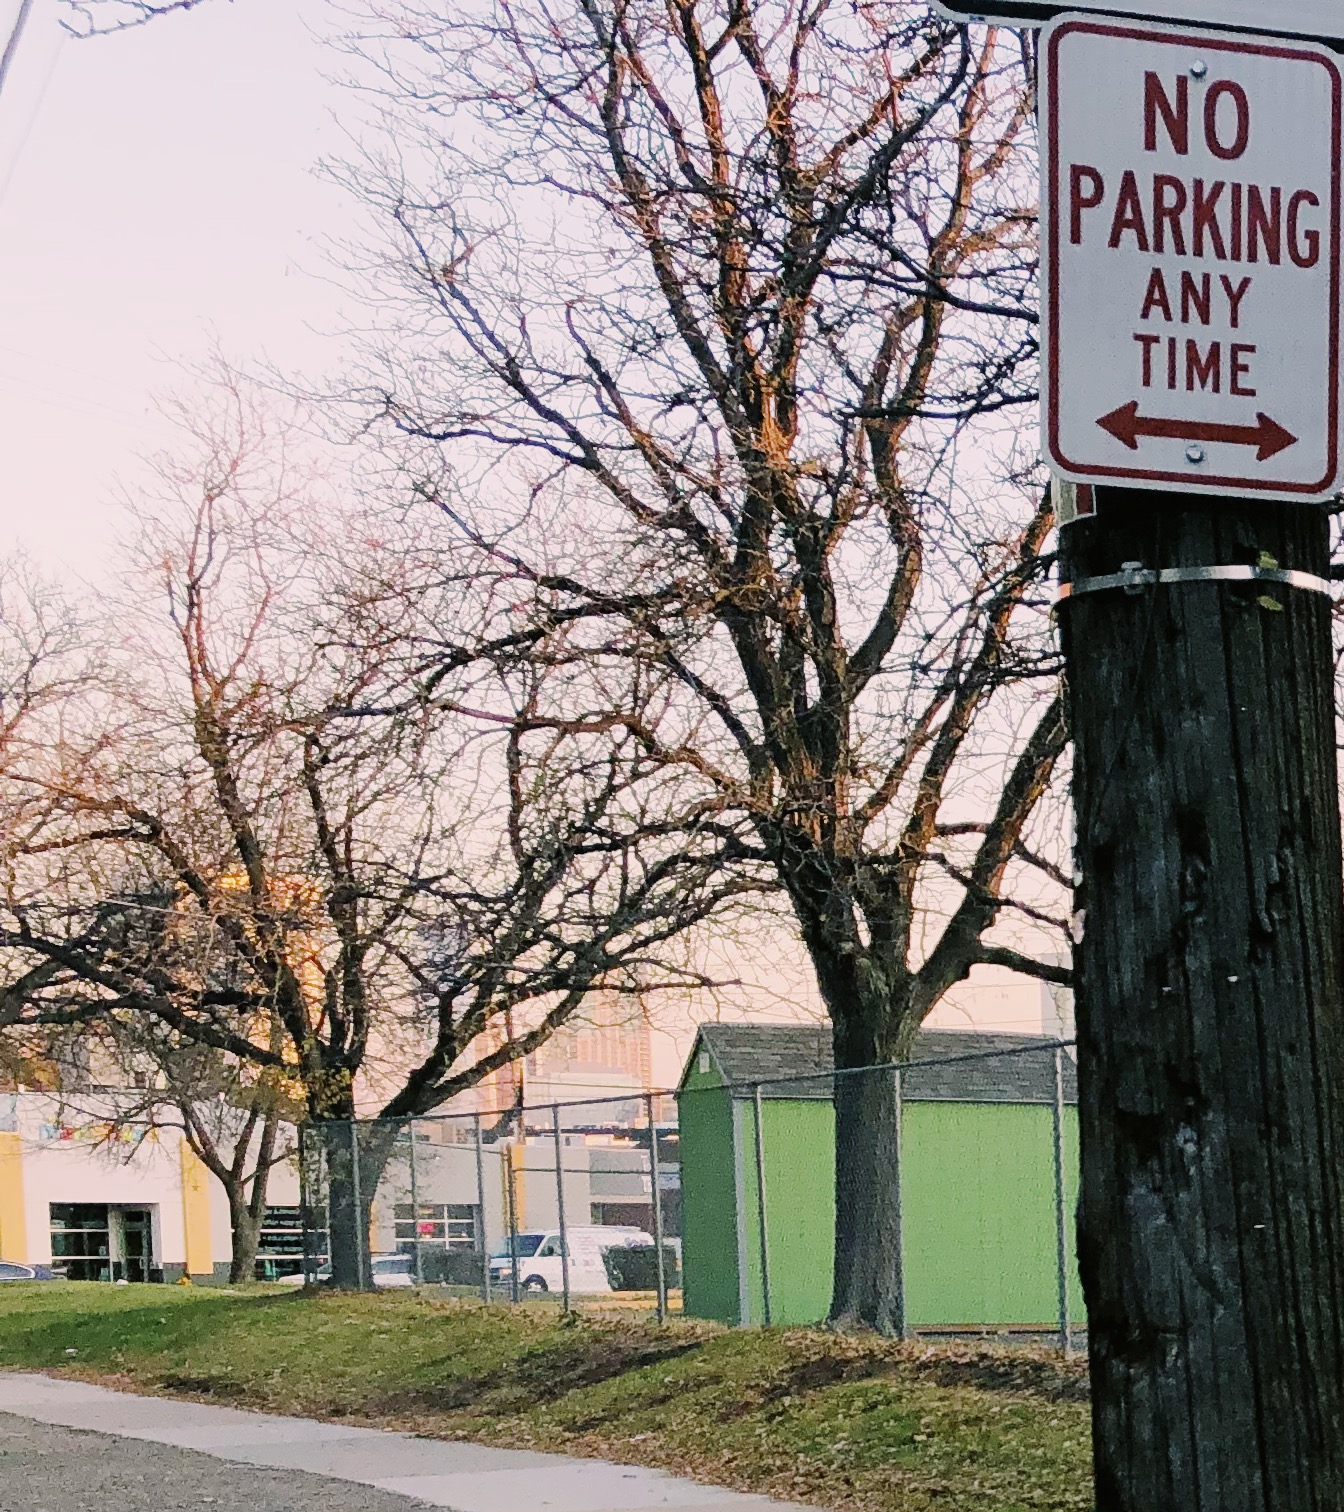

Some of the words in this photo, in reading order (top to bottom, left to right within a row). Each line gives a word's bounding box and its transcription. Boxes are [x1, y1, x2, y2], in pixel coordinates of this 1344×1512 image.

[1143, 71, 1249, 160] NO
[1069, 164, 1320, 268] PARKING
[1140, 268, 1252, 329] ANY
[1132, 333, 1257, 398] TIME
